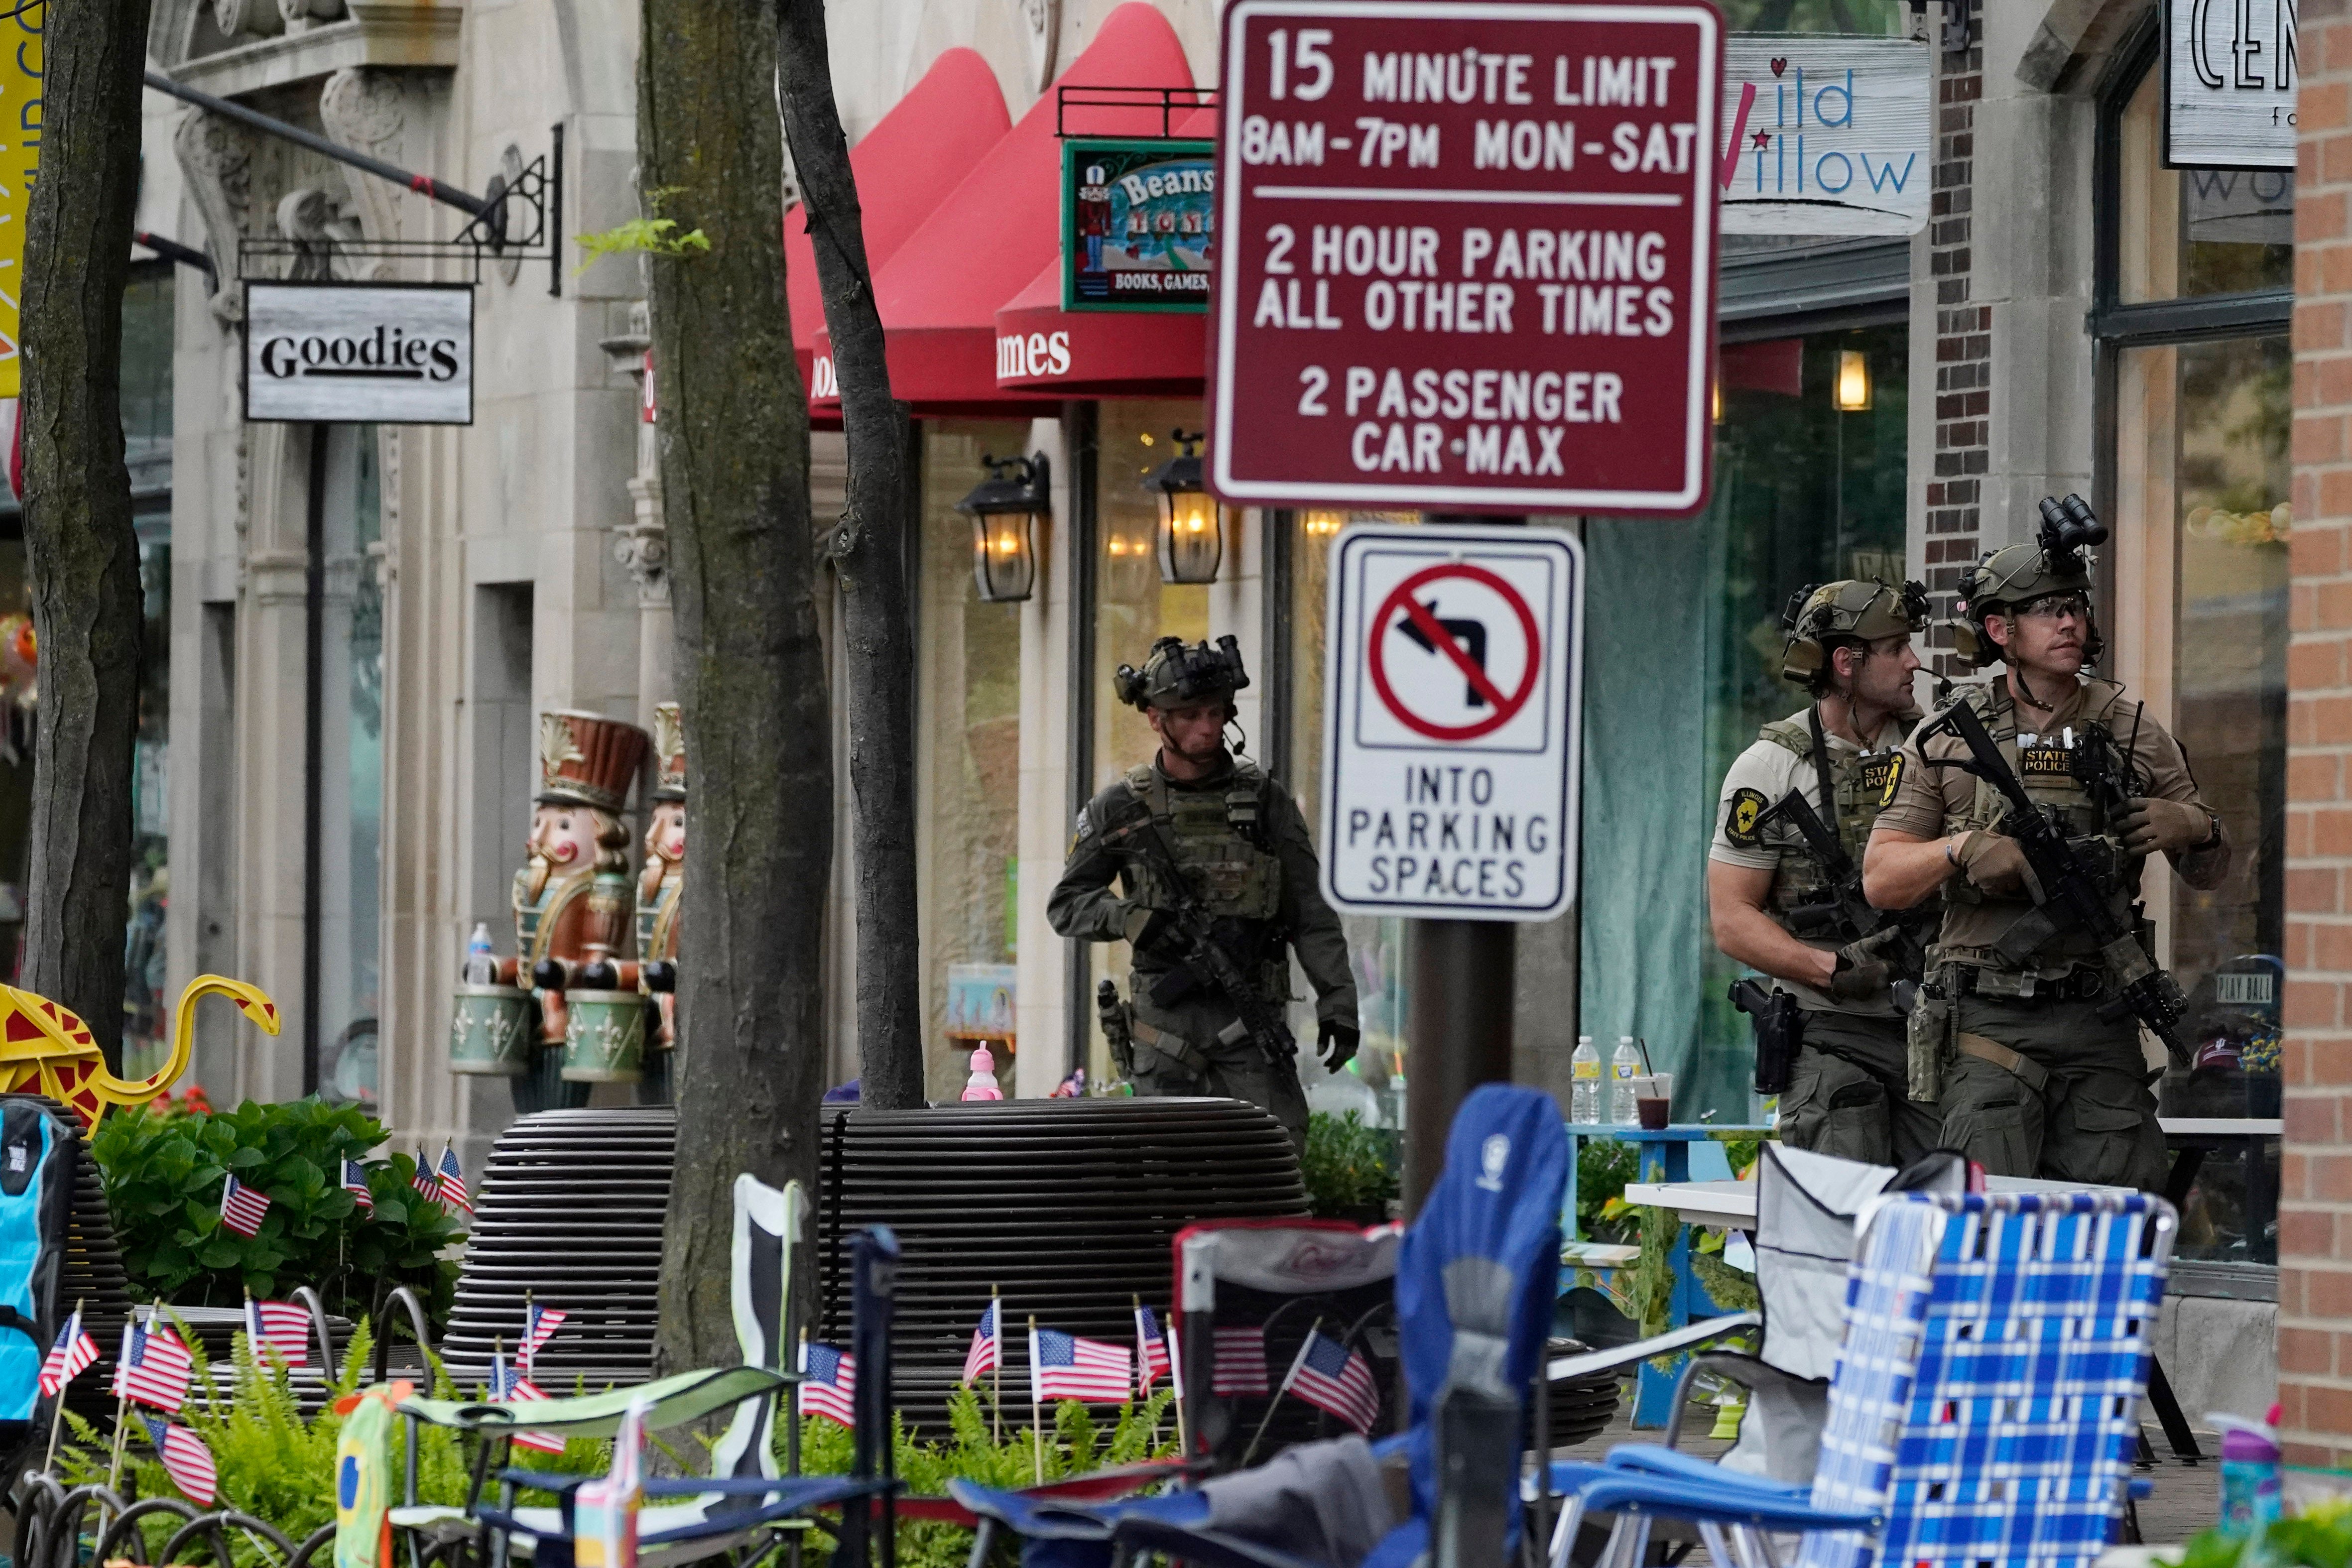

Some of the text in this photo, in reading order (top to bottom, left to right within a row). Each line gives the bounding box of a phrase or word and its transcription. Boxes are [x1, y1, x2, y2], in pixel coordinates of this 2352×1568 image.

[1267, 28, 1677, 108] 15 MINUTE LIMIT
[1241, 115, 1696, 173] 8AM-7PM MON-SAT
[1263, 224, 1666, 282] 2 HOUR PARKING
[1115, 273, 1210, 292] BOOKS, GAMES,
[1253, 279, 1674, 337] ALL OTHER TIMES
[261, 325, 458, 381] Goodies
[996, 331, 1071, 379] mes
[1298, 365, 1623, 423] 2 PASSENGER
[1352, 421, 1564, 476] CAR MAX
[2025, 761, 2070, 772] POLICE
[2027, 750, 2070, 761] STATE
[1405, 766, 1493, 806] INTO
[1741, 791, 1764, 804] ILLINOIS
[1349, 809, 1548, 854] PARKING
[1727, 827, 1739, 839] STATE
[1369, 855, 1524, 898] SPACES
[2219, 977, 2270, 1000] PLAY BALL
